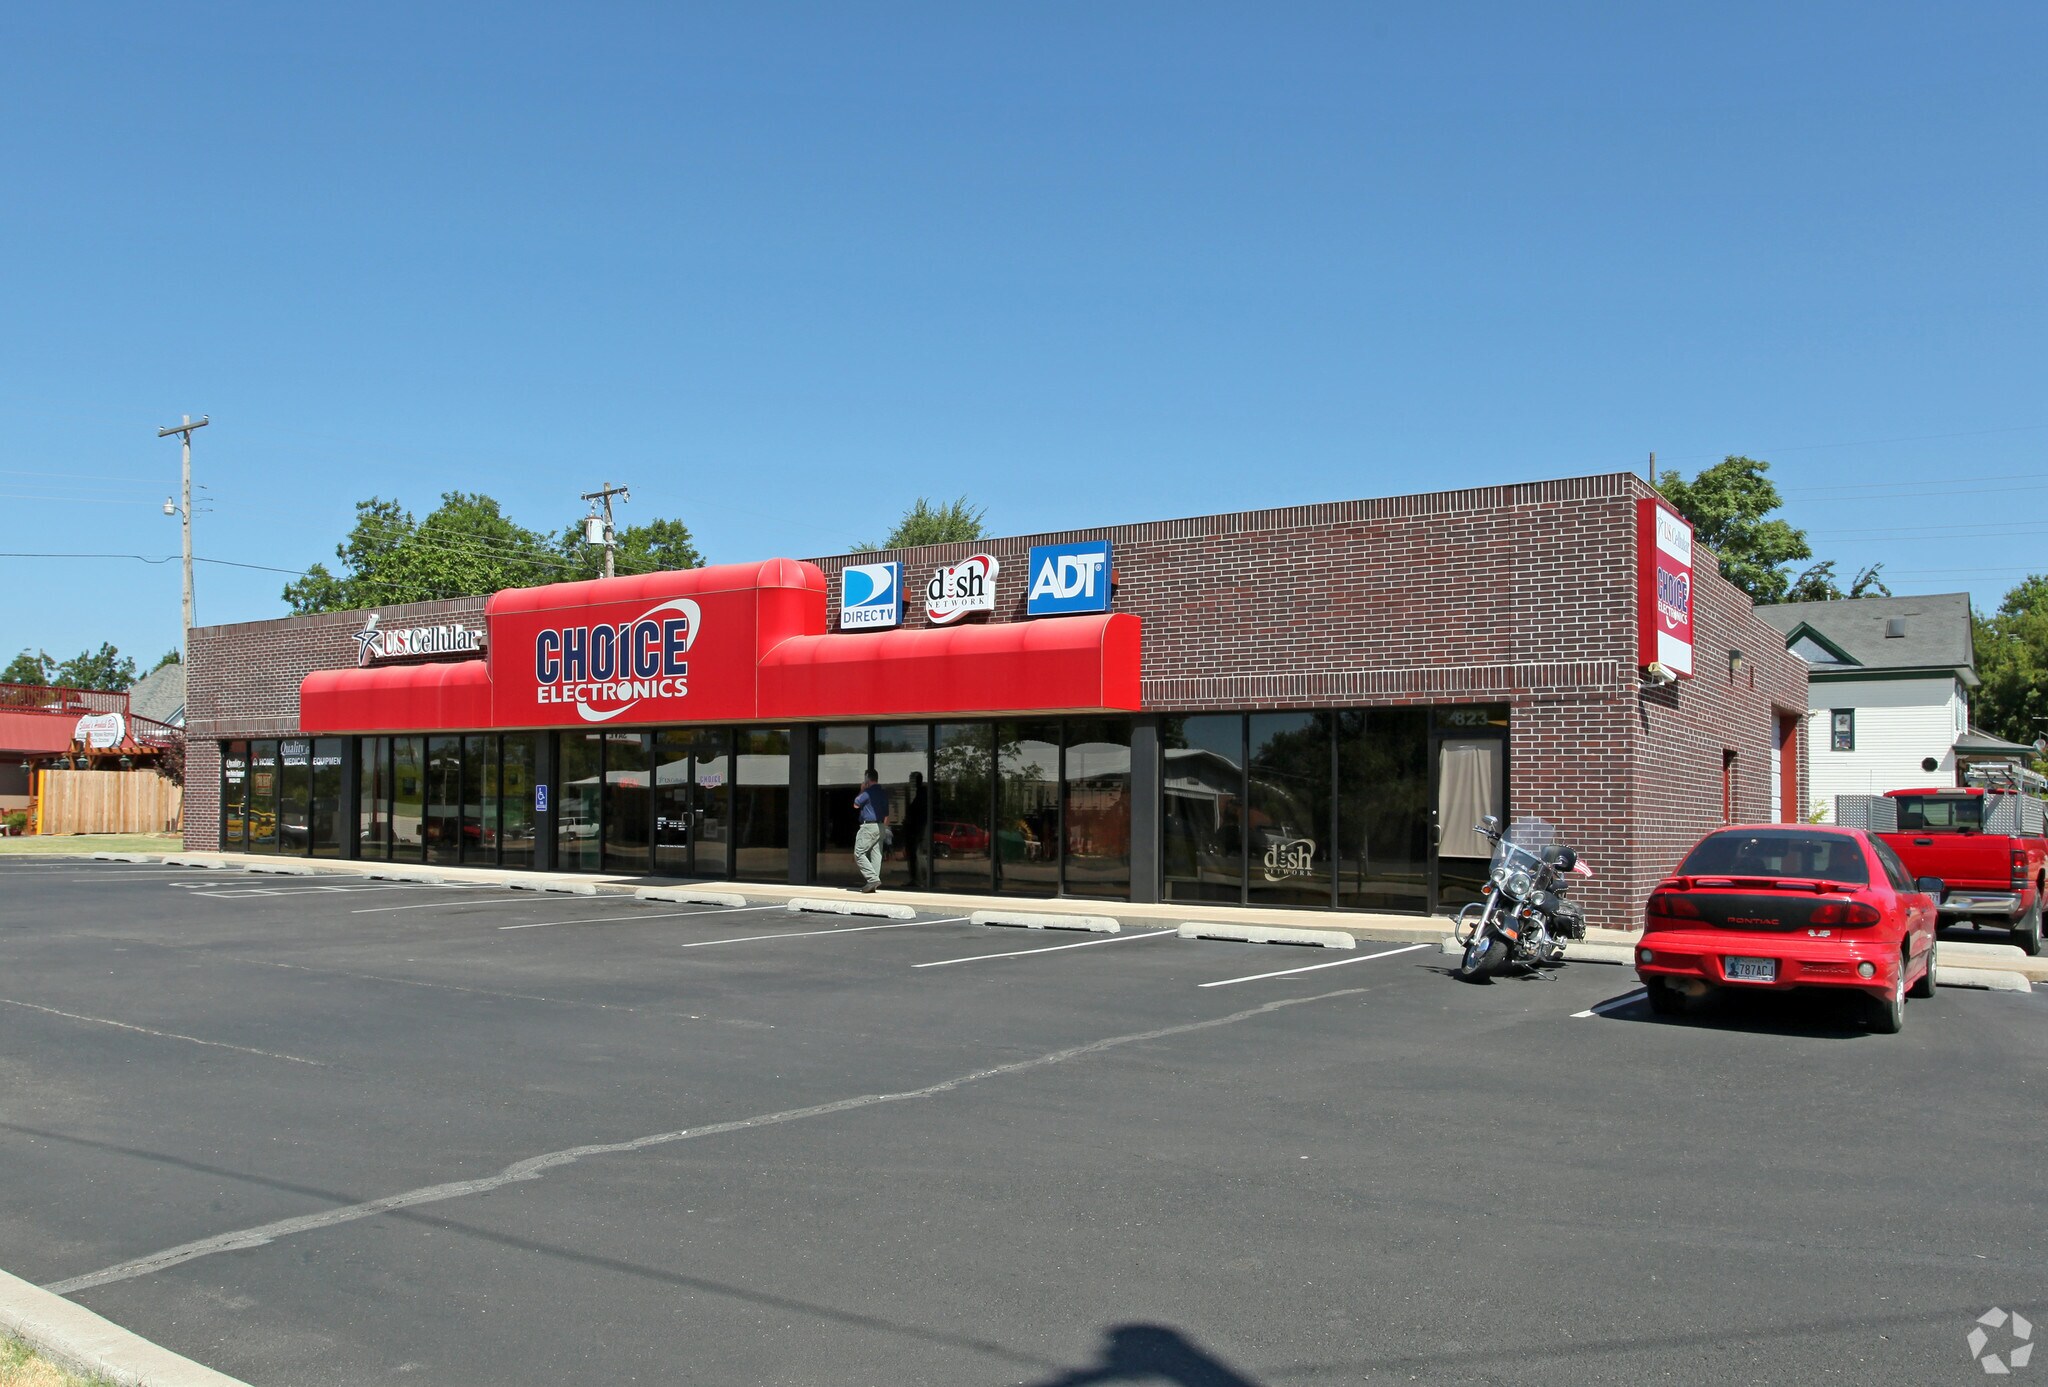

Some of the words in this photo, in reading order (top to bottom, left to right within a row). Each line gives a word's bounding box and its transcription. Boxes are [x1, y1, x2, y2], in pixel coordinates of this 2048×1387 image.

[928, 565, 985, 600] dish
[1029, 552, 1105, 600] ADT
[1656, 566, 1688, 614] CHOICE
[928, 598, 984, 609] NETWORK
[1657, 600, 1688, 625] ELECTRONICS
[843, 608, 894, 624] DIRECTV
[383, 629, 408, 656] U.S.
[410, 625, 476, 653] Cellular
[535, 617, 688, 685] CHOICE
[537, 678, 689, 704] ELECTRONICS
[281, 741, 304, 756] Quality
[259, 758, 275, 766] HOME
[284, 758, 307, 766] MEDICAL
[313, 757, 342, 766] EQUIPMEN
[700, 775, 721, 784] CHOICE
[1263, 842, 1312, 870] dish
[1263, 868, 1312, 876] NETWORK
[1727, 917, 1780, 925] PONTIAC
[1740, 964, 1774, 977] 787ACJ
